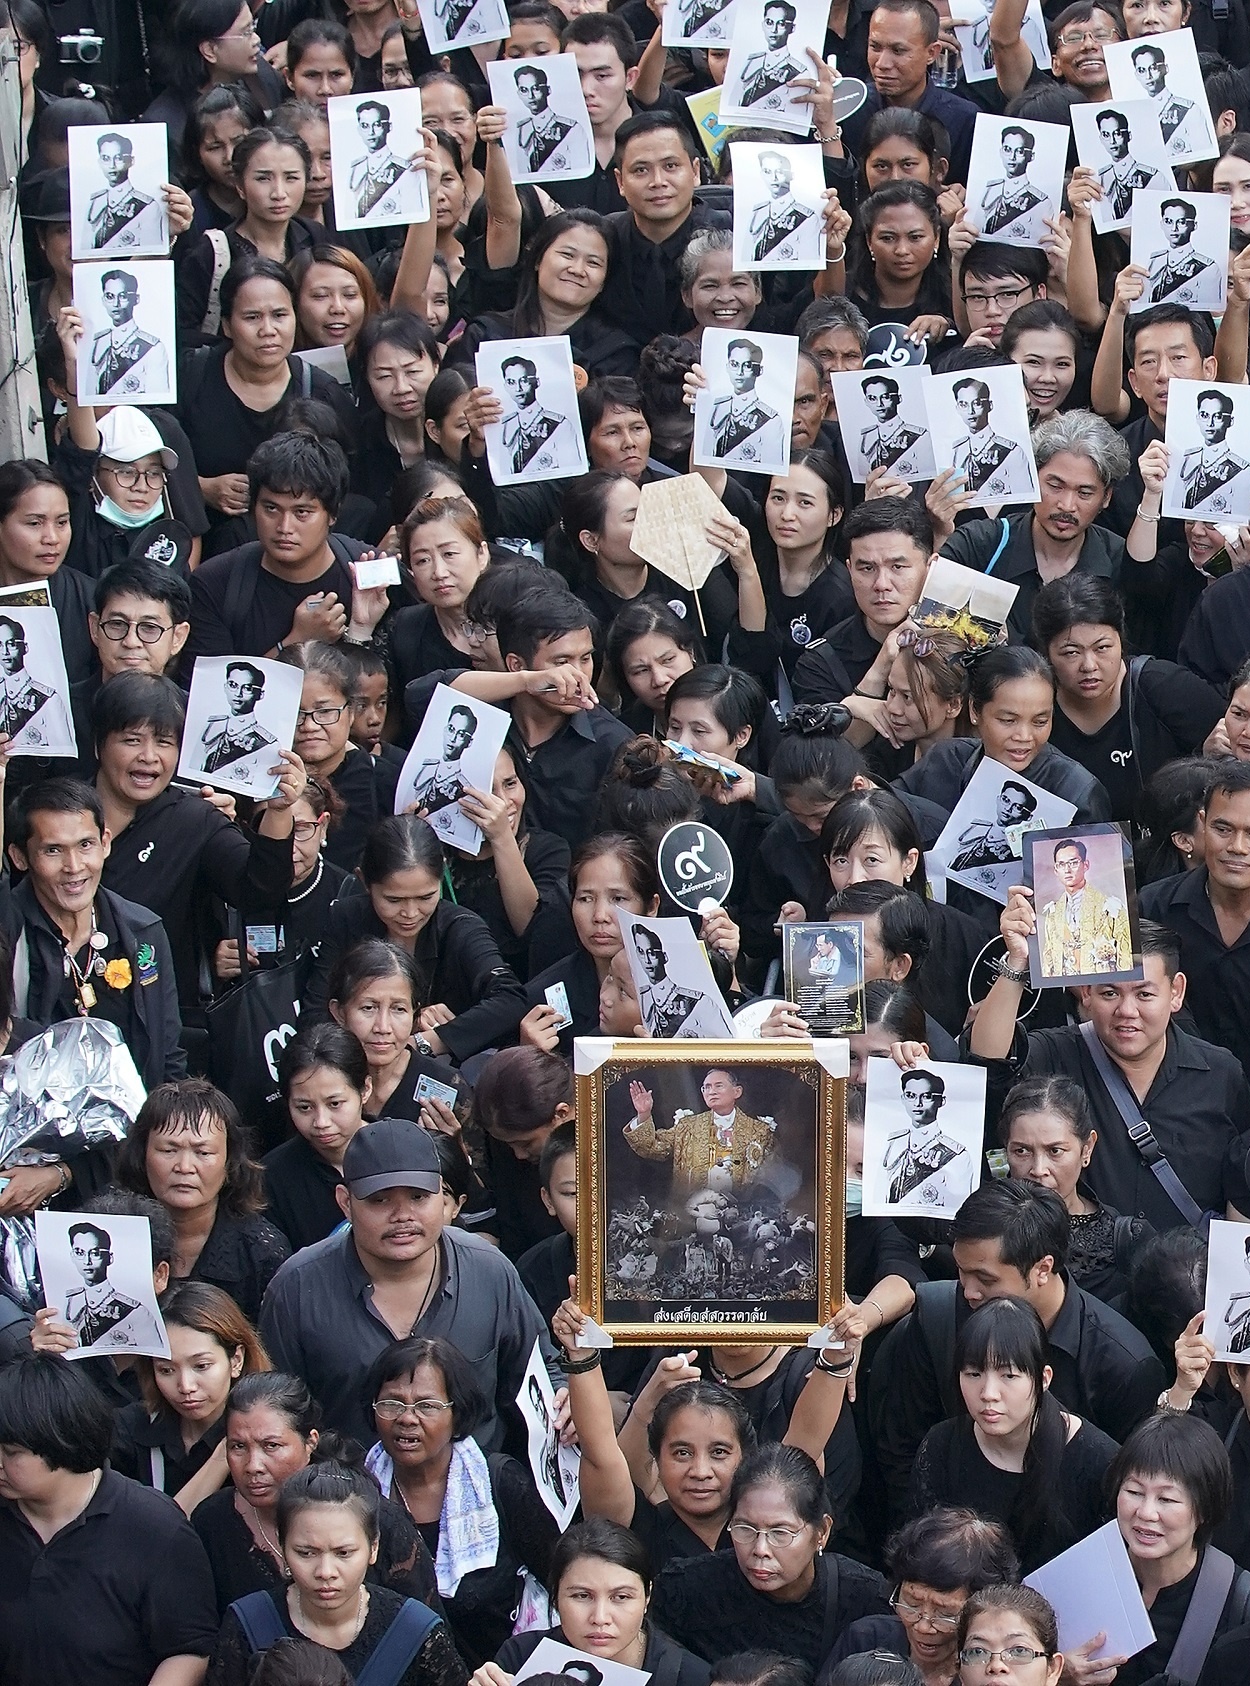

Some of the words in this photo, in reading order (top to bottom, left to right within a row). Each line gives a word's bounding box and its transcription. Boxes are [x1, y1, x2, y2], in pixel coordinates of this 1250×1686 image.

[674, 830, 712, 880] ๙
[653, 1304, 768, 1324] ส่งเสด็จสู่สวรรคาลัย
